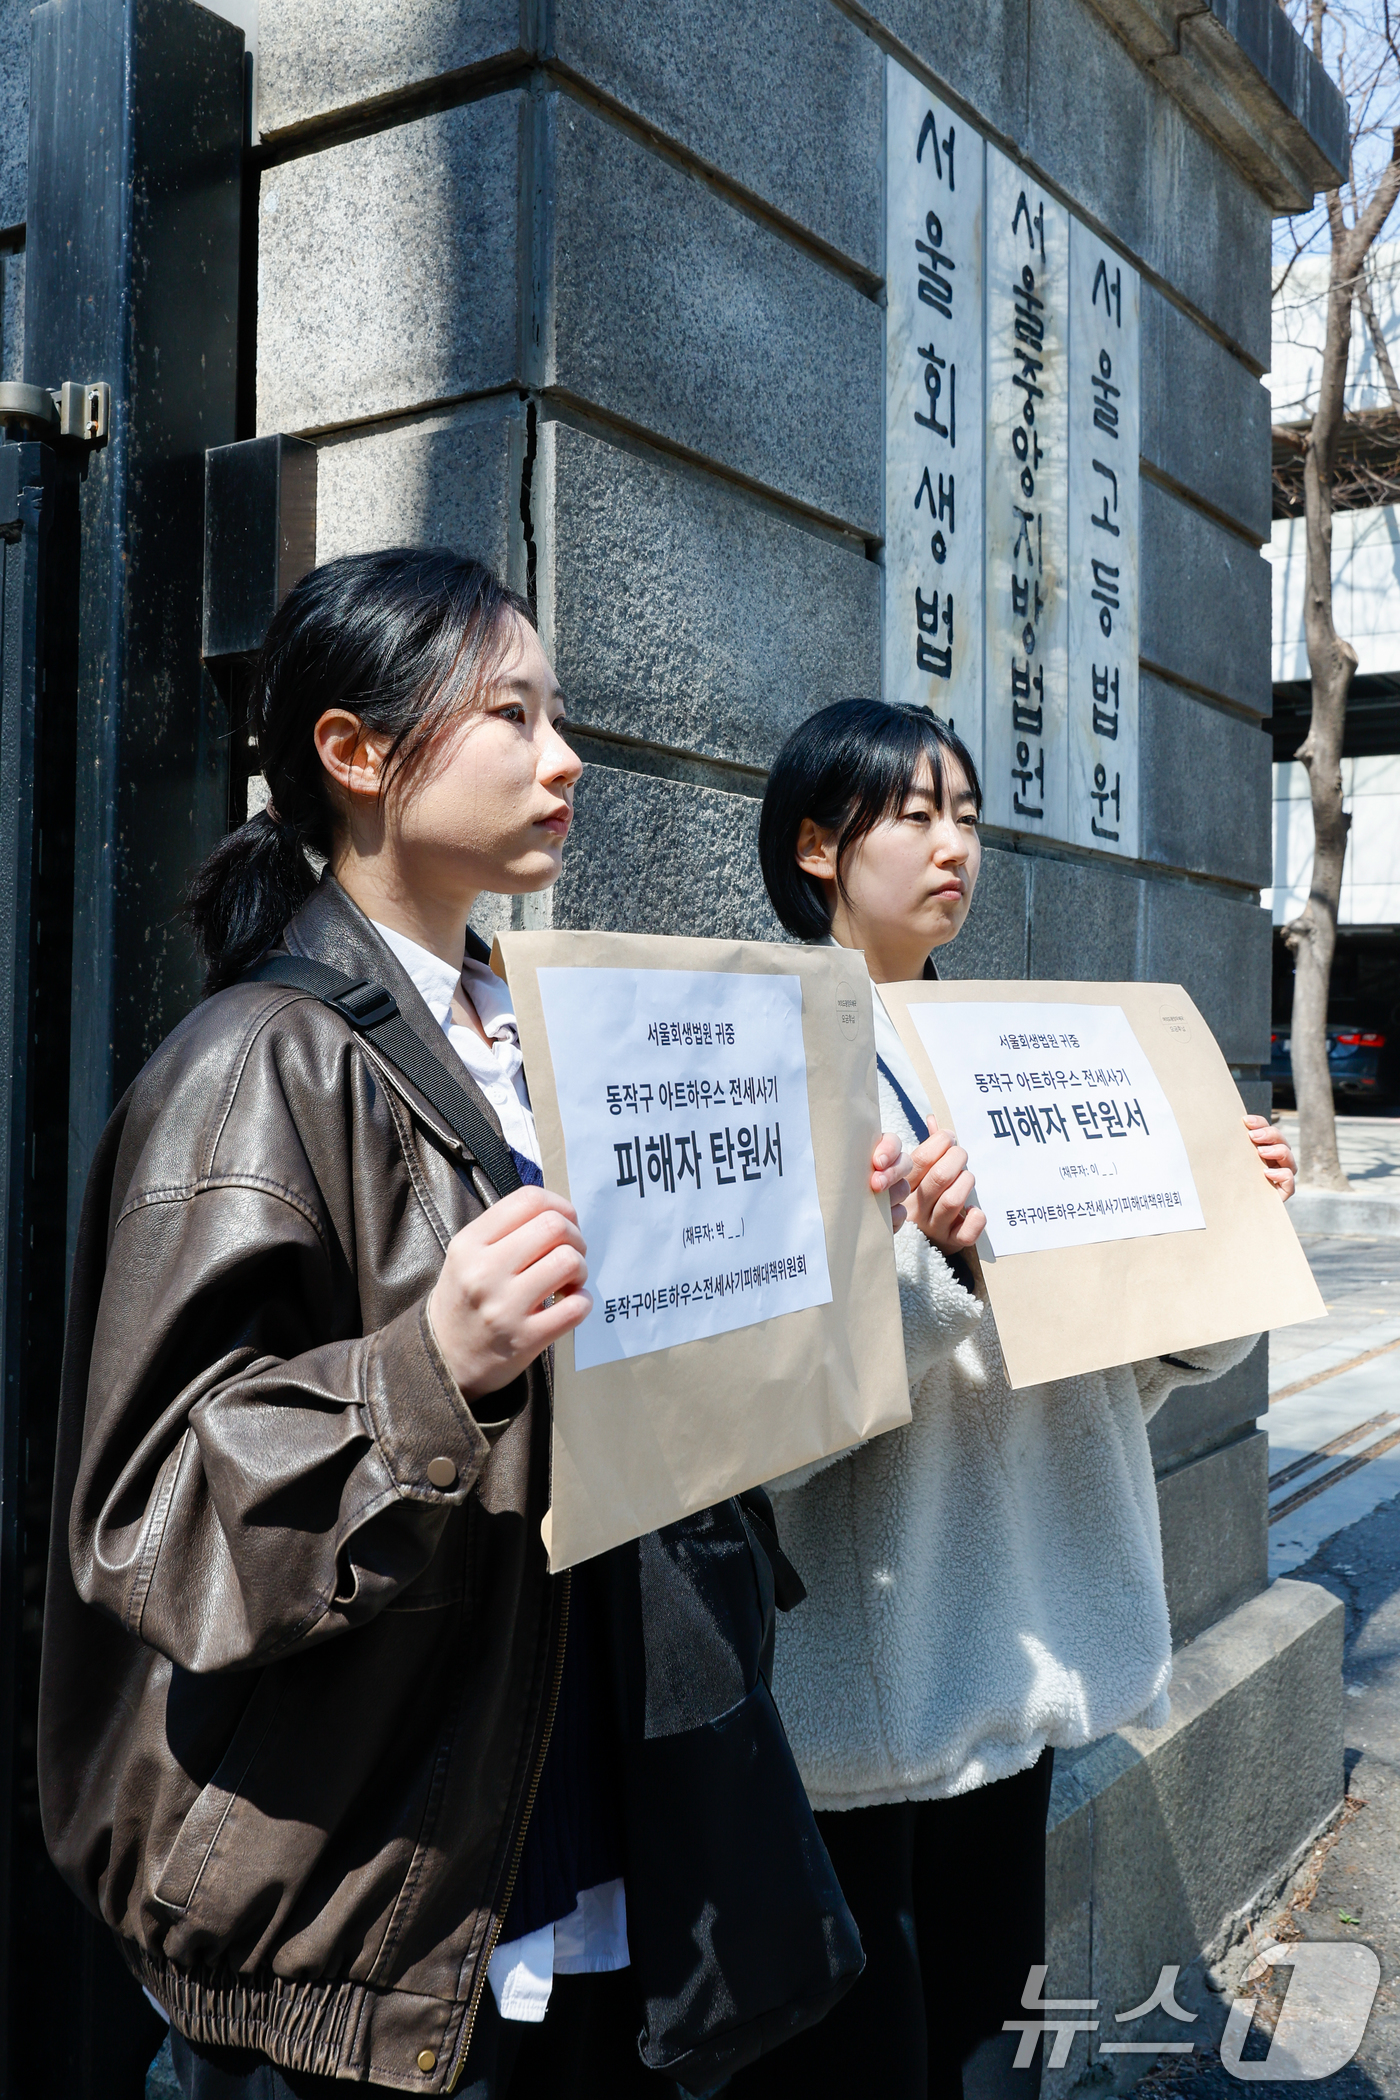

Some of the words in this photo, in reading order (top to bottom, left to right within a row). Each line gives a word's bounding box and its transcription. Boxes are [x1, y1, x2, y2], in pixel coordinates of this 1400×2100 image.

[914, 109, 956, 733] 서울회생법
[1011, 191, 1045, 820] 서울중앙지방법원
[1090, 259, 1121, 843] 서울고등법원
[647, 1021, 713, 1046] 서울회생법원
[715, 1022, 735, 1045] 귀중
[999, 1033, 1060, 1050] 서울회생법원
[1058, 1033, 1081, 1049] 귀중
[606, 1082, 654, 1115] 동작구
[658, 1079, 726, 1111] 아트하우스
[728, 1075, 779, 1106] 전세사기
[974, 1072, 1014, 1093] 동작구
[1016, 1070, 1082, 1092] 아트하우스
[1081, 1068, 1132, 1088] 전세사기
[987, 1103, 1071, 1147] 피해자
[1071, 1098, 1150, 1140] 탄원서
[613, 1130, 703, 1198] 피해자
[709, 1121, 783, 1186] 탄원서
[1058, 1165, 1090, 1181] (채무자:
[1090, 1163, 1100, 1176] 이
[1006, 1191, 1183, 1227] 동작구아트하우스전세사기피해대책위원회
[682, 1223, 715, 1249] (채무자:
[715, 1220, 725, 1239] 박
[604, 1253, 808, 1324] 동작구아트하우스전세사기피해대책위원회
